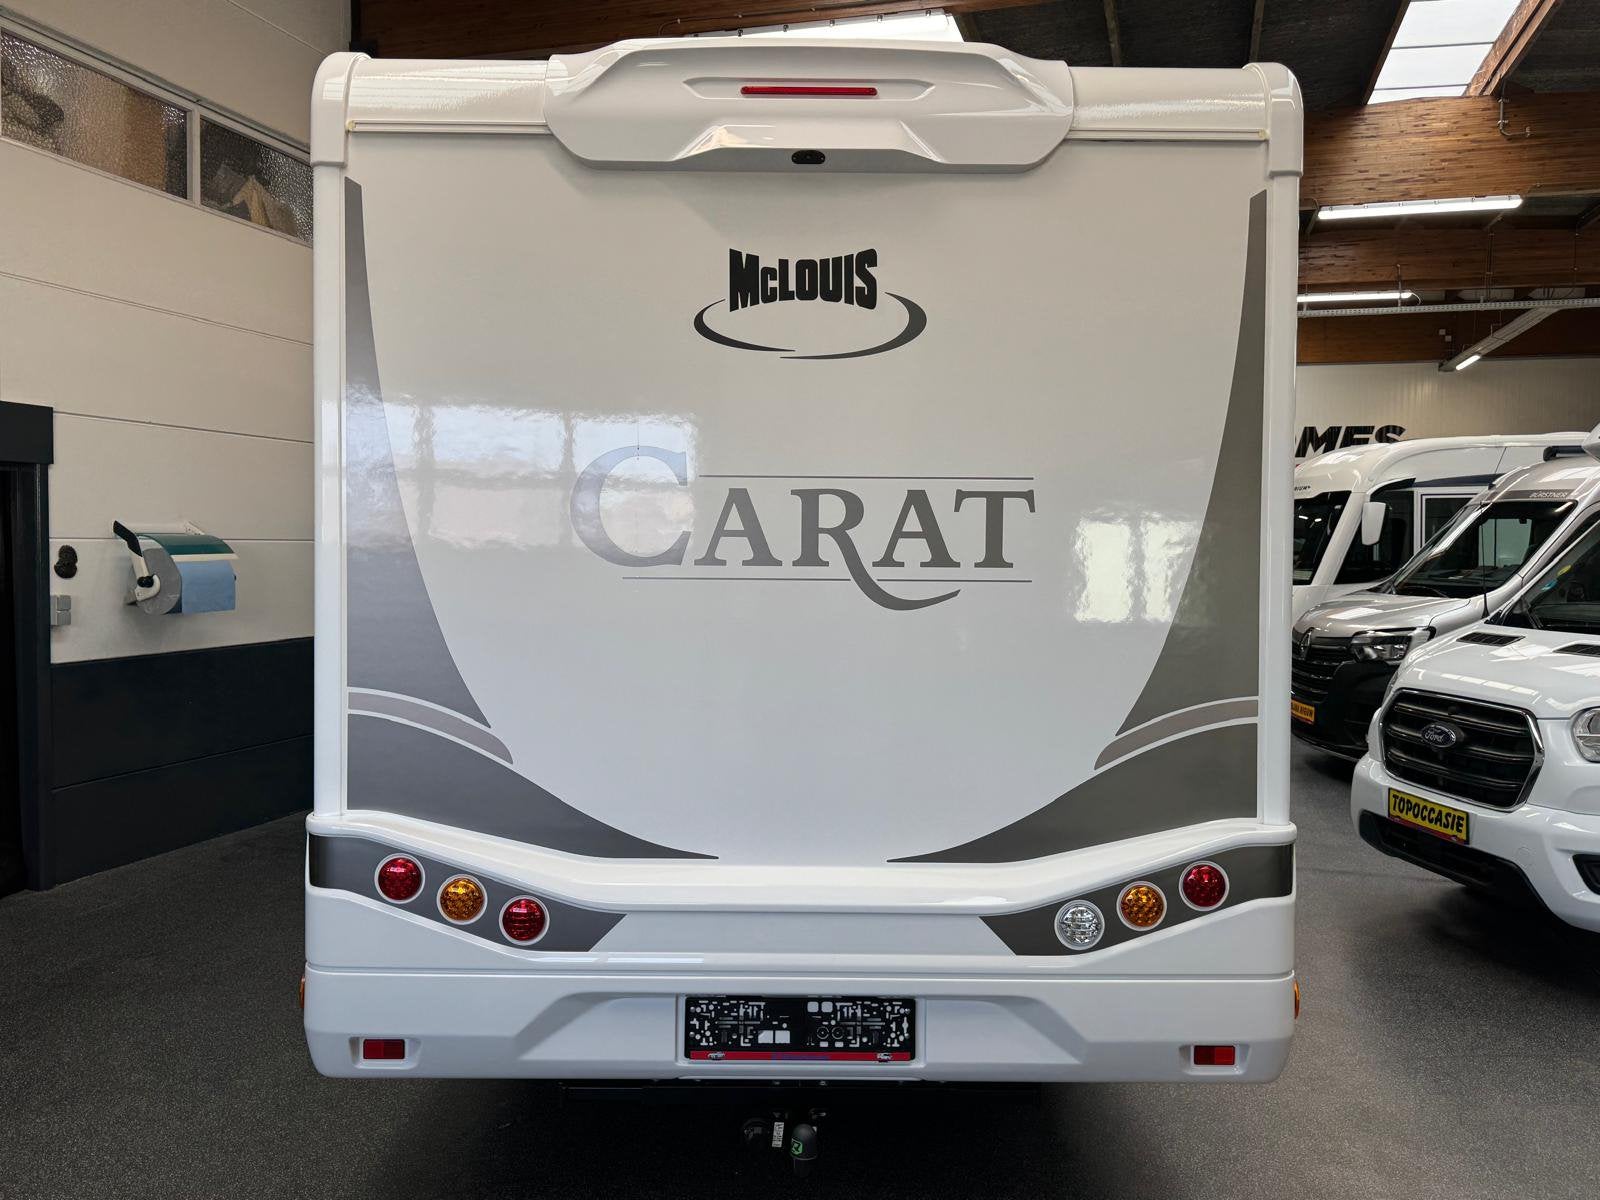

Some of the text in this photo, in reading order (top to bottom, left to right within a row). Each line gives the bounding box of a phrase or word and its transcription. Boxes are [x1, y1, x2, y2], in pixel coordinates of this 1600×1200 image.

[729, 247, 878, 313] McLOUIS
[1295, 424, 1407, 458] MES
[569, 444, 1036, 611] CARAT
[1424, 727, 1446, 743] Ford
[1392, 793, 1465, 834] TOPOCCASIE
